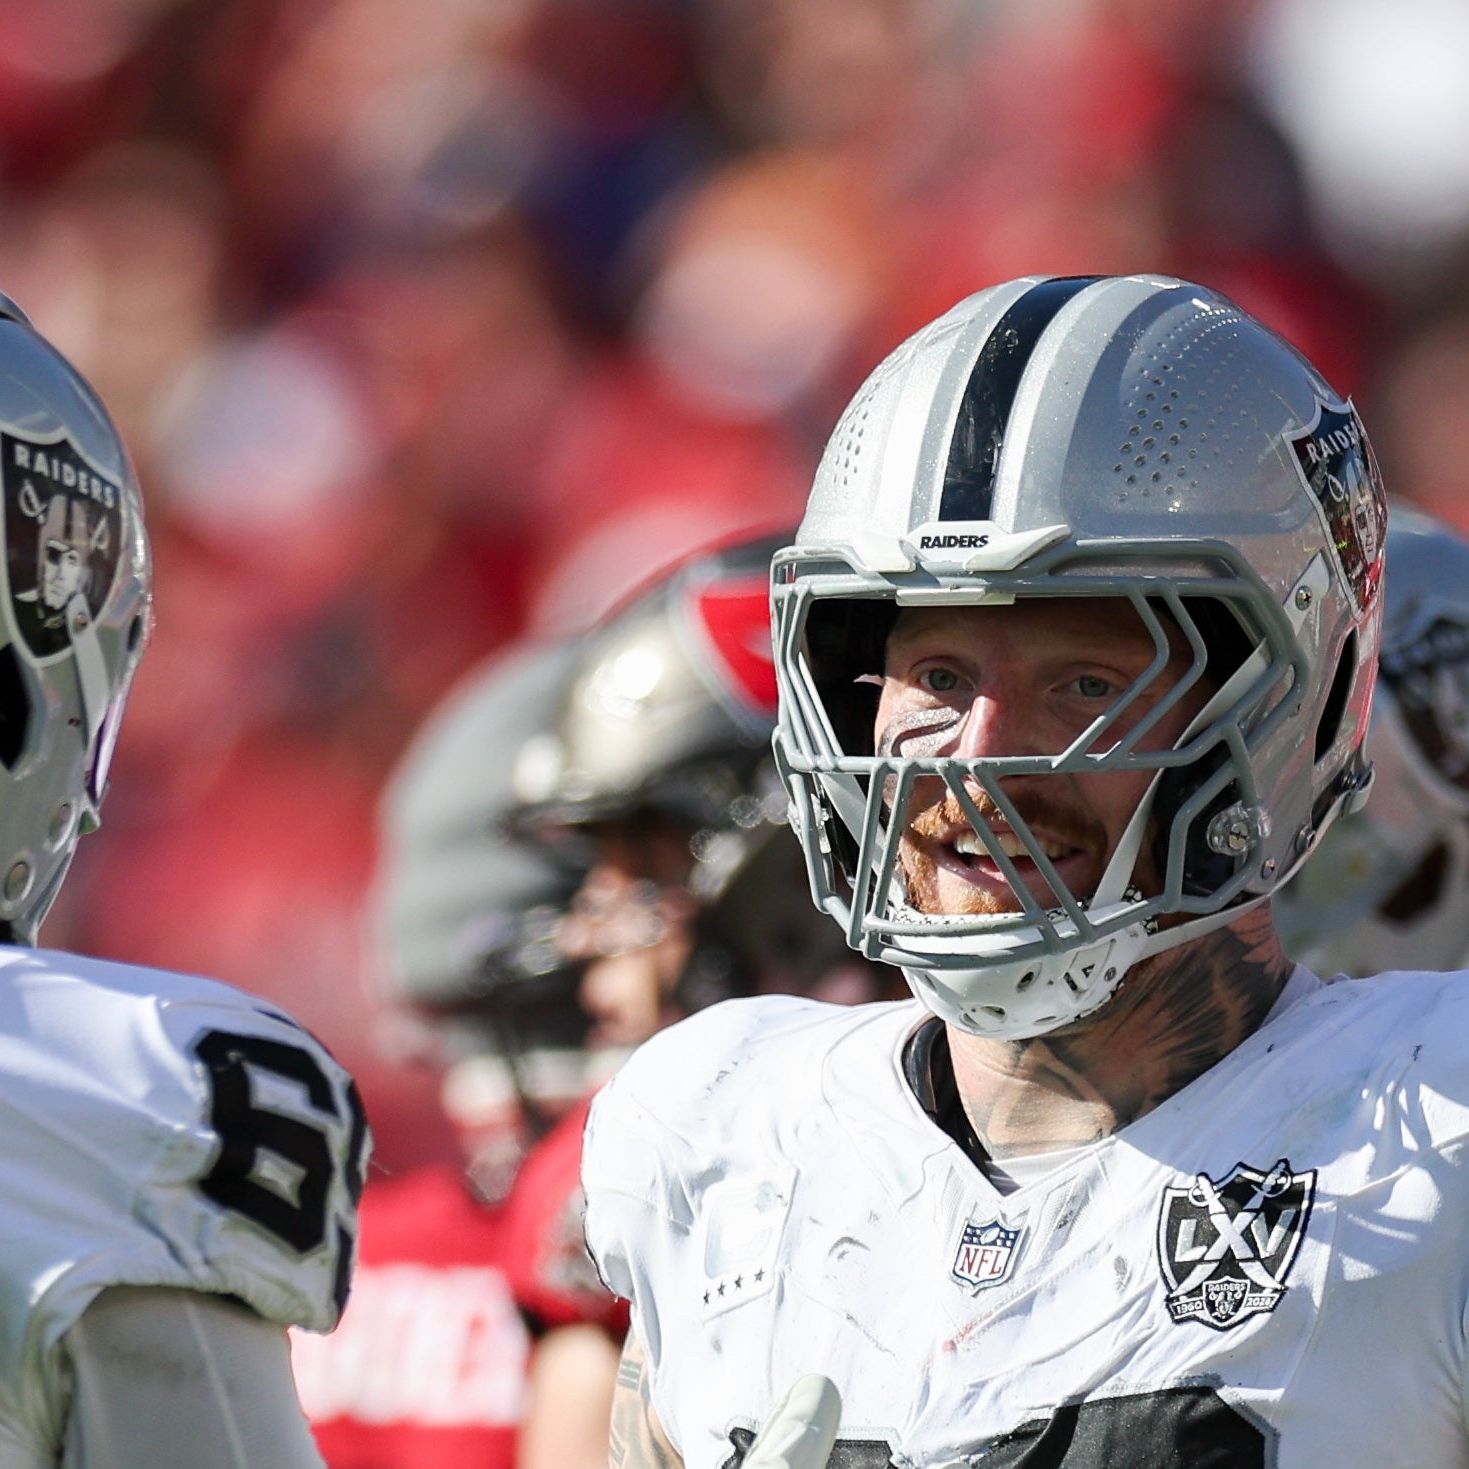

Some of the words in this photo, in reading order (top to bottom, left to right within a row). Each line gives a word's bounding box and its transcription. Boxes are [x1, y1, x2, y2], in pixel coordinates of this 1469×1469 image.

[14, 443, 115, 509] RAIDERS
[920, 535, 989, 549] RAIDERS
[1175, 1209, 1297, 1262] LXV
[959, 1247, 1003, 1278] NFL
[1208, 1283, 1246, 1292] RAIDERS
[1176, 1301, 1203, 1314] 1960
